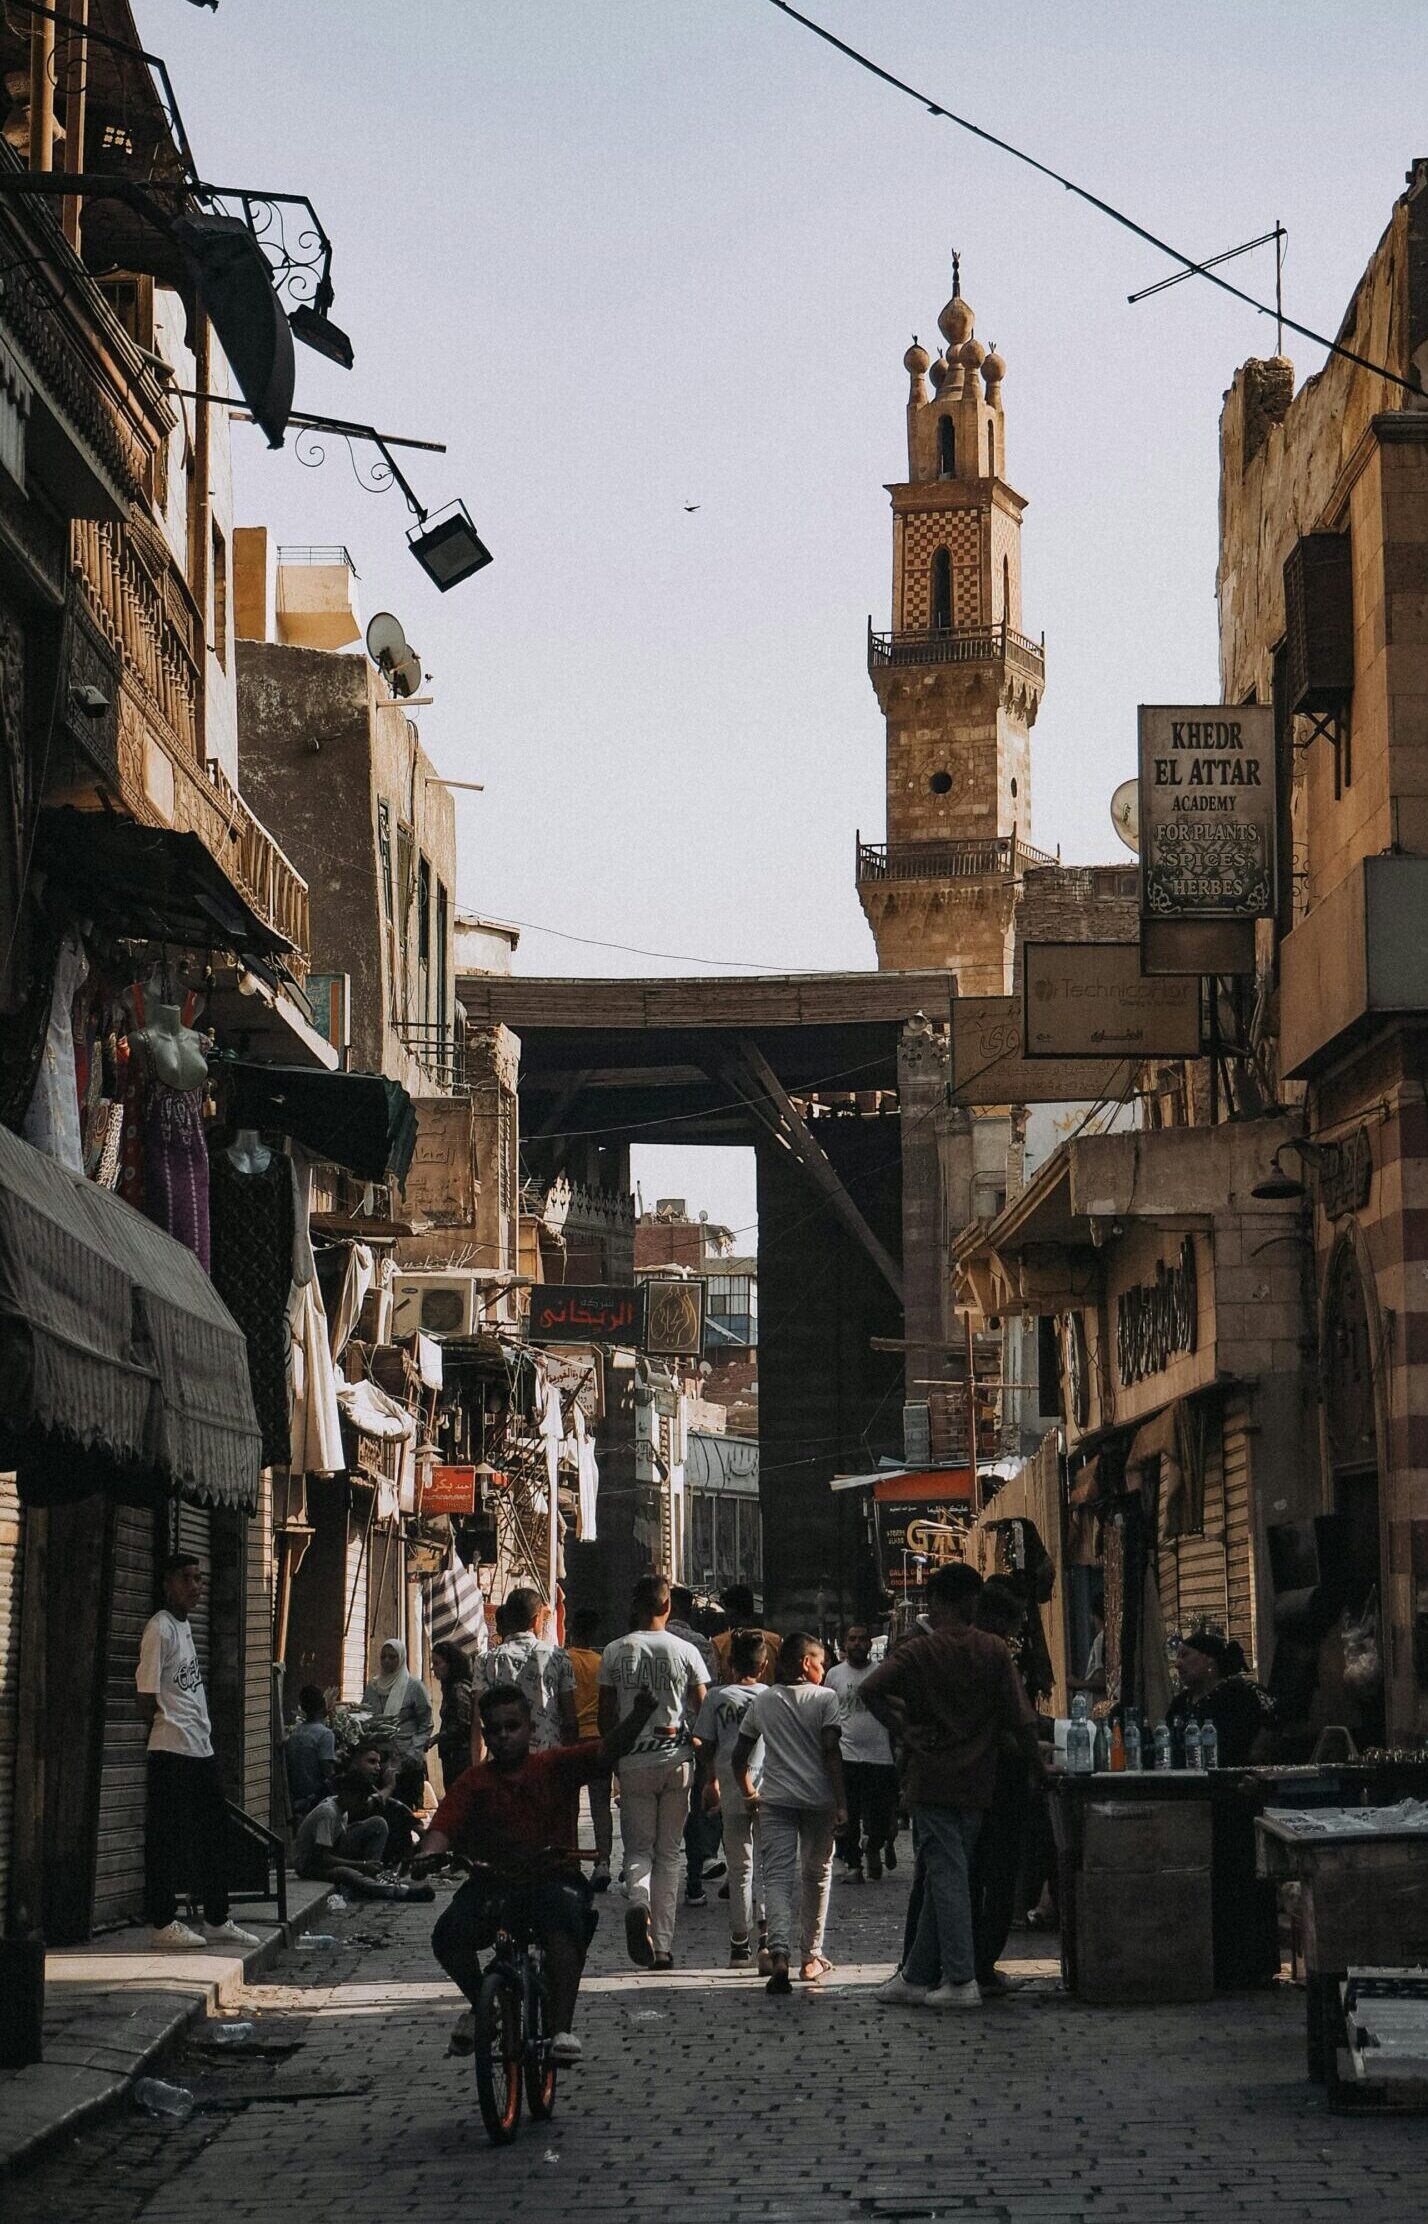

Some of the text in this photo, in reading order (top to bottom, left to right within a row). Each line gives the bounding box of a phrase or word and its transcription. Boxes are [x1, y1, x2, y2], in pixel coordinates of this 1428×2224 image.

[1171, 721, 1244, 750] KHEDR
[1154, 758, 1262, 786] EL ATTAR
[1171, 795, 1237, 811] ACADEMY
[1156, 823, 1261, 842] FOR PLANTS,
[1173, 878, 1244, 896] HERBES
